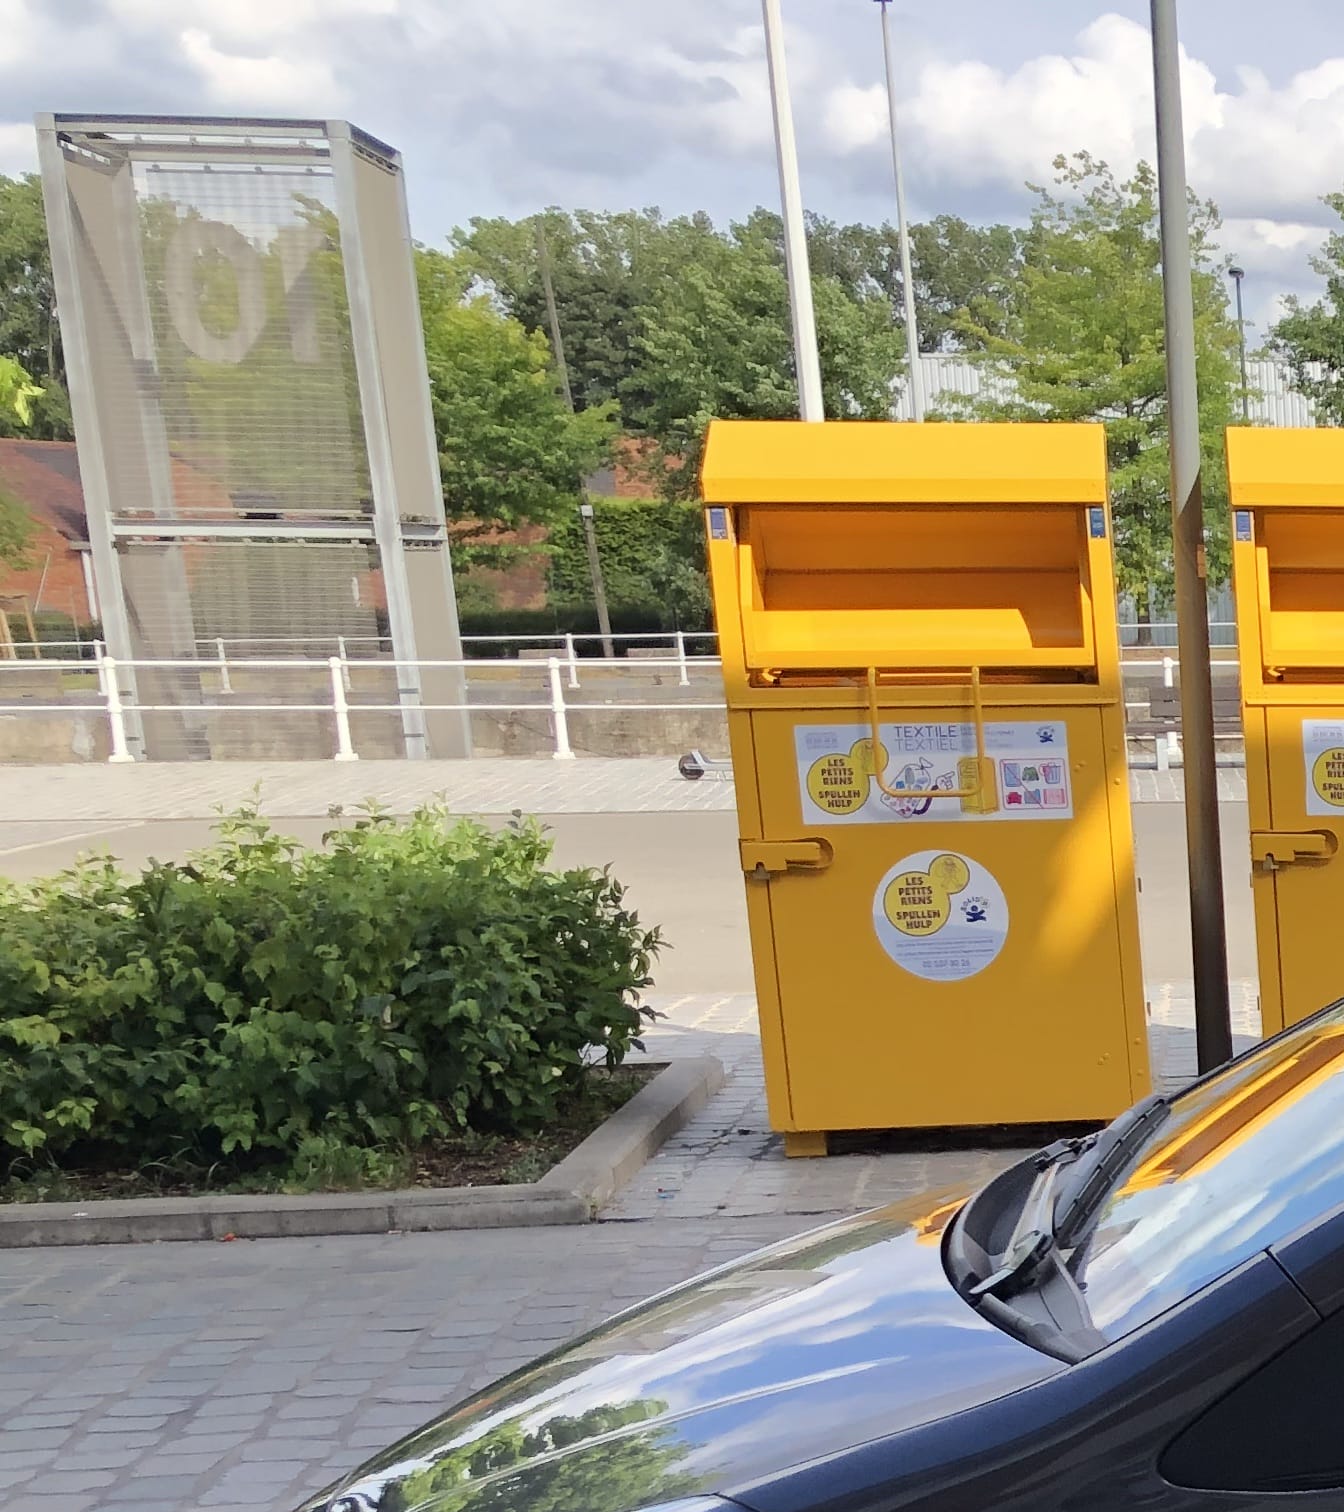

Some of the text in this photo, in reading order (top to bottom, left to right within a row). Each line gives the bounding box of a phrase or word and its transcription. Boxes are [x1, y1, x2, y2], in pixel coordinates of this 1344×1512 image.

[894, 725, 957, 738] TEXTILE
[894, 738, 958, 751] TEXTIEL
[827, 758, 845, 767] LES
[821, 768, 854, 777] PETITS
[818, 789, 861, 799] SPULLEN
[827, 798, 853, 808] HULP
[905, 877, 924, 886] LES
[898, 886, 933, 896] PETITS
[901, 896, 932, 906] RIENS
[896, 909, 940, 920] SPULLEN
[906, 920, 933, 929] HULP
